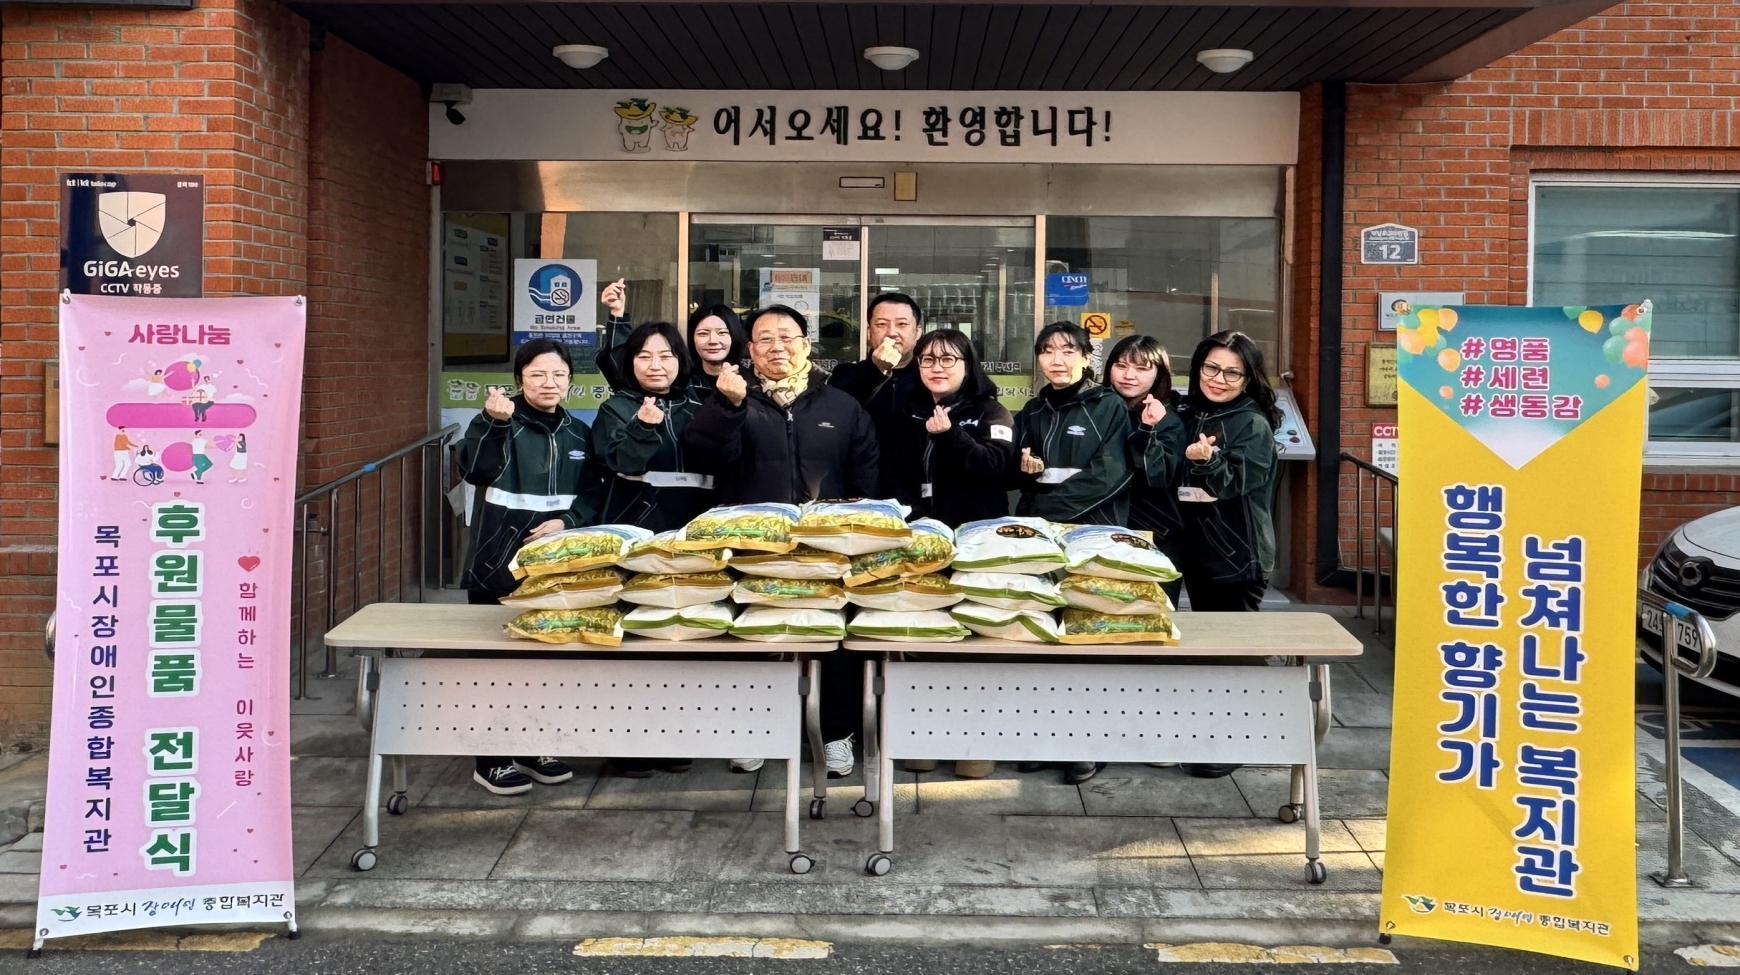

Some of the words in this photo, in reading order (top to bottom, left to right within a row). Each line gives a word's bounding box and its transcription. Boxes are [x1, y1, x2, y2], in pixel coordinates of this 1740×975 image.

[713, 105, 901, 146] 어서오세요!
[922, 105, 1112, 147] 환영합니다!
[83, 260, 135, 278] GiGA
[135, 264, 180, 281] eyes
[1379, 244, 1402, 260] 12
[100, 283, 130, 294] CCTV
[128, 324, 232, 346] 사랑나눔
[1462, 338, 1550, 362] #명품
[1462, 367, 1549, 390] #세련
[1462, 396, 1582, 419] #생동감
[1373, 426, 1398, 440] CCT
[1444, 484, 1505, 628] 행복한
[150, 503, 201, 694] 후원물품
[236, 581, 259, 670] 함께하는
[1520, 536, 1586, 732] 넘쳐나는
[83, 525, 122, 854] 목포시장애인종합복지관
[1439, 641, 1504, 788] 향기가
[234, 699, 256, 787] 이웃사랑
[146, 730, 196, 873] 전달식
[1514, 744, 1580, 898] 복지관
[86, 902, 137, 918] 목포시
